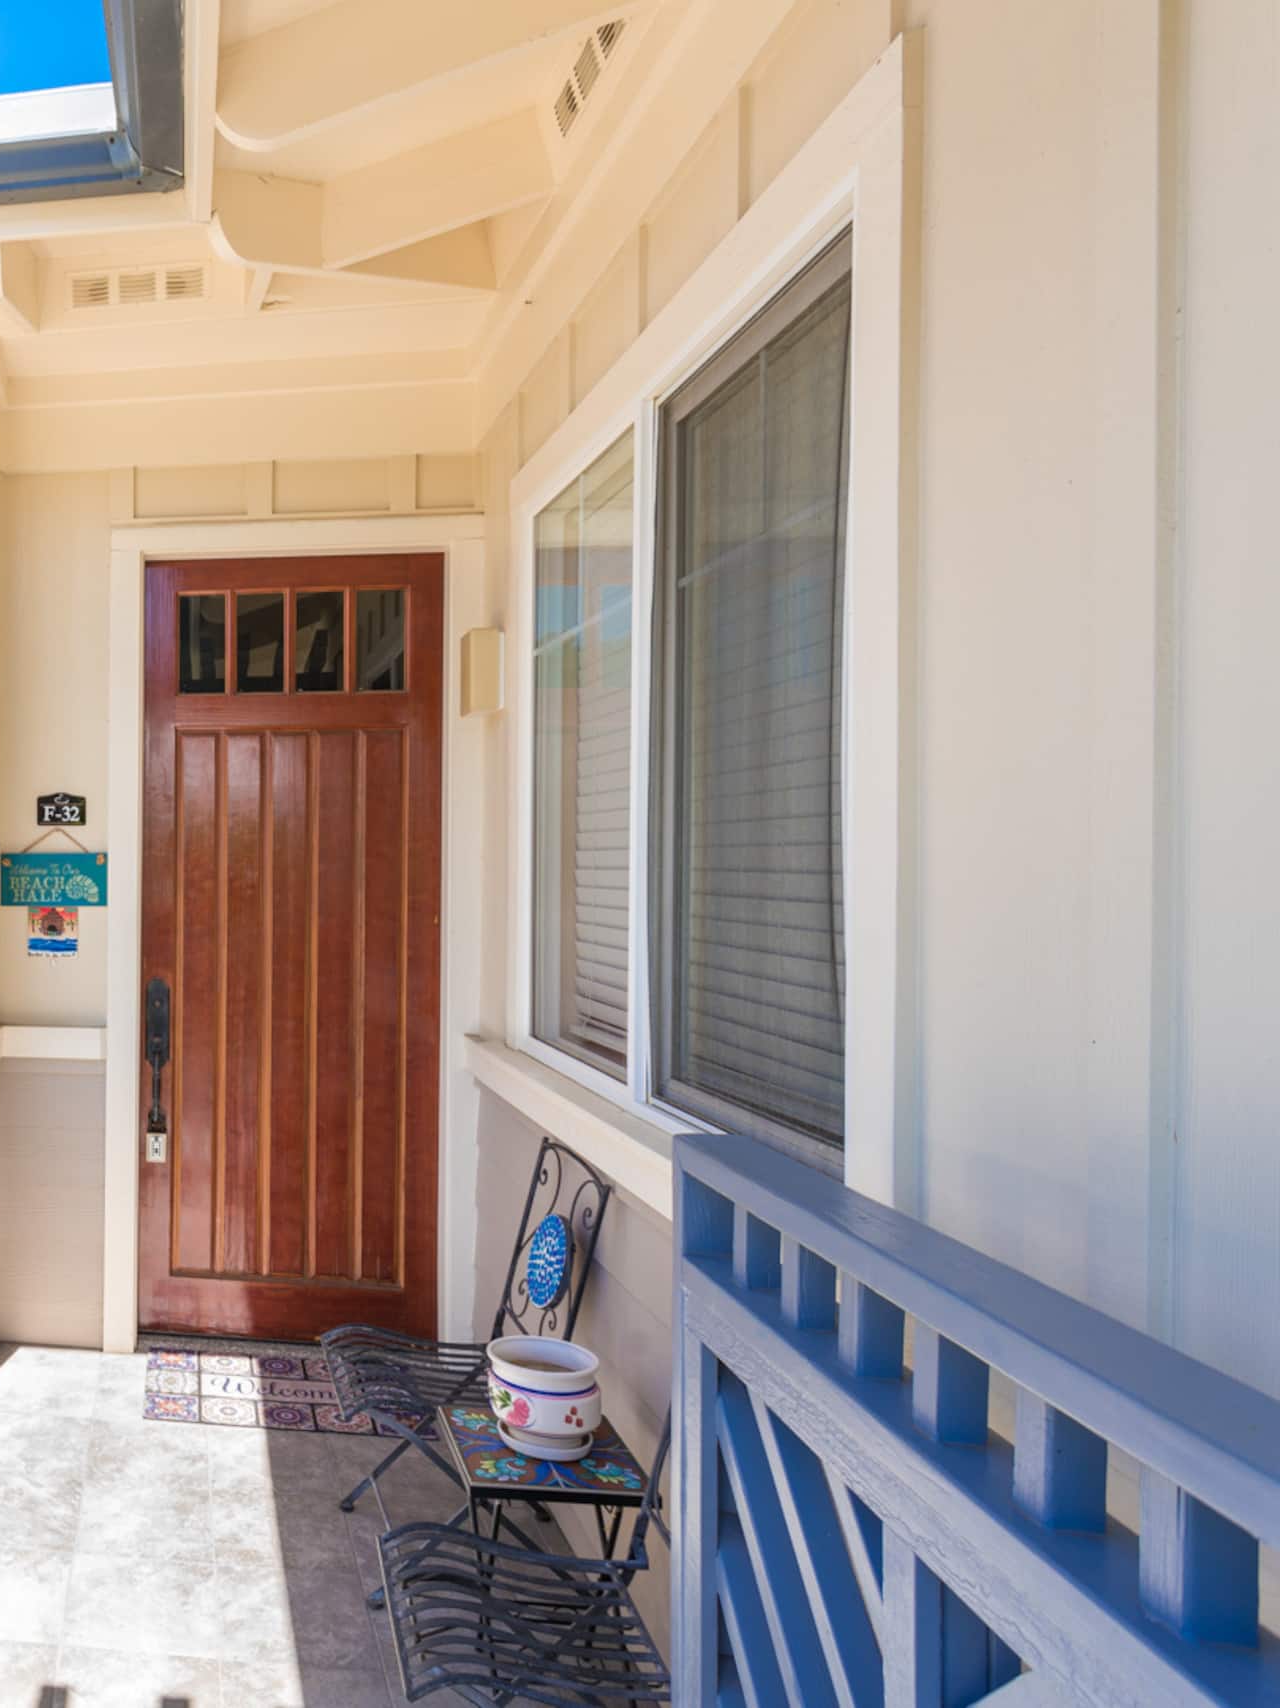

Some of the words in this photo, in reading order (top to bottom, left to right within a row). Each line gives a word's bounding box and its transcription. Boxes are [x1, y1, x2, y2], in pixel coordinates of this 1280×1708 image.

[43, 806, 80, 822] F-32
[10, 876, 65, 889] BEACH
[13, 889, 62, 903] HALE
[210, 1376, 336, 1399] Welcom
